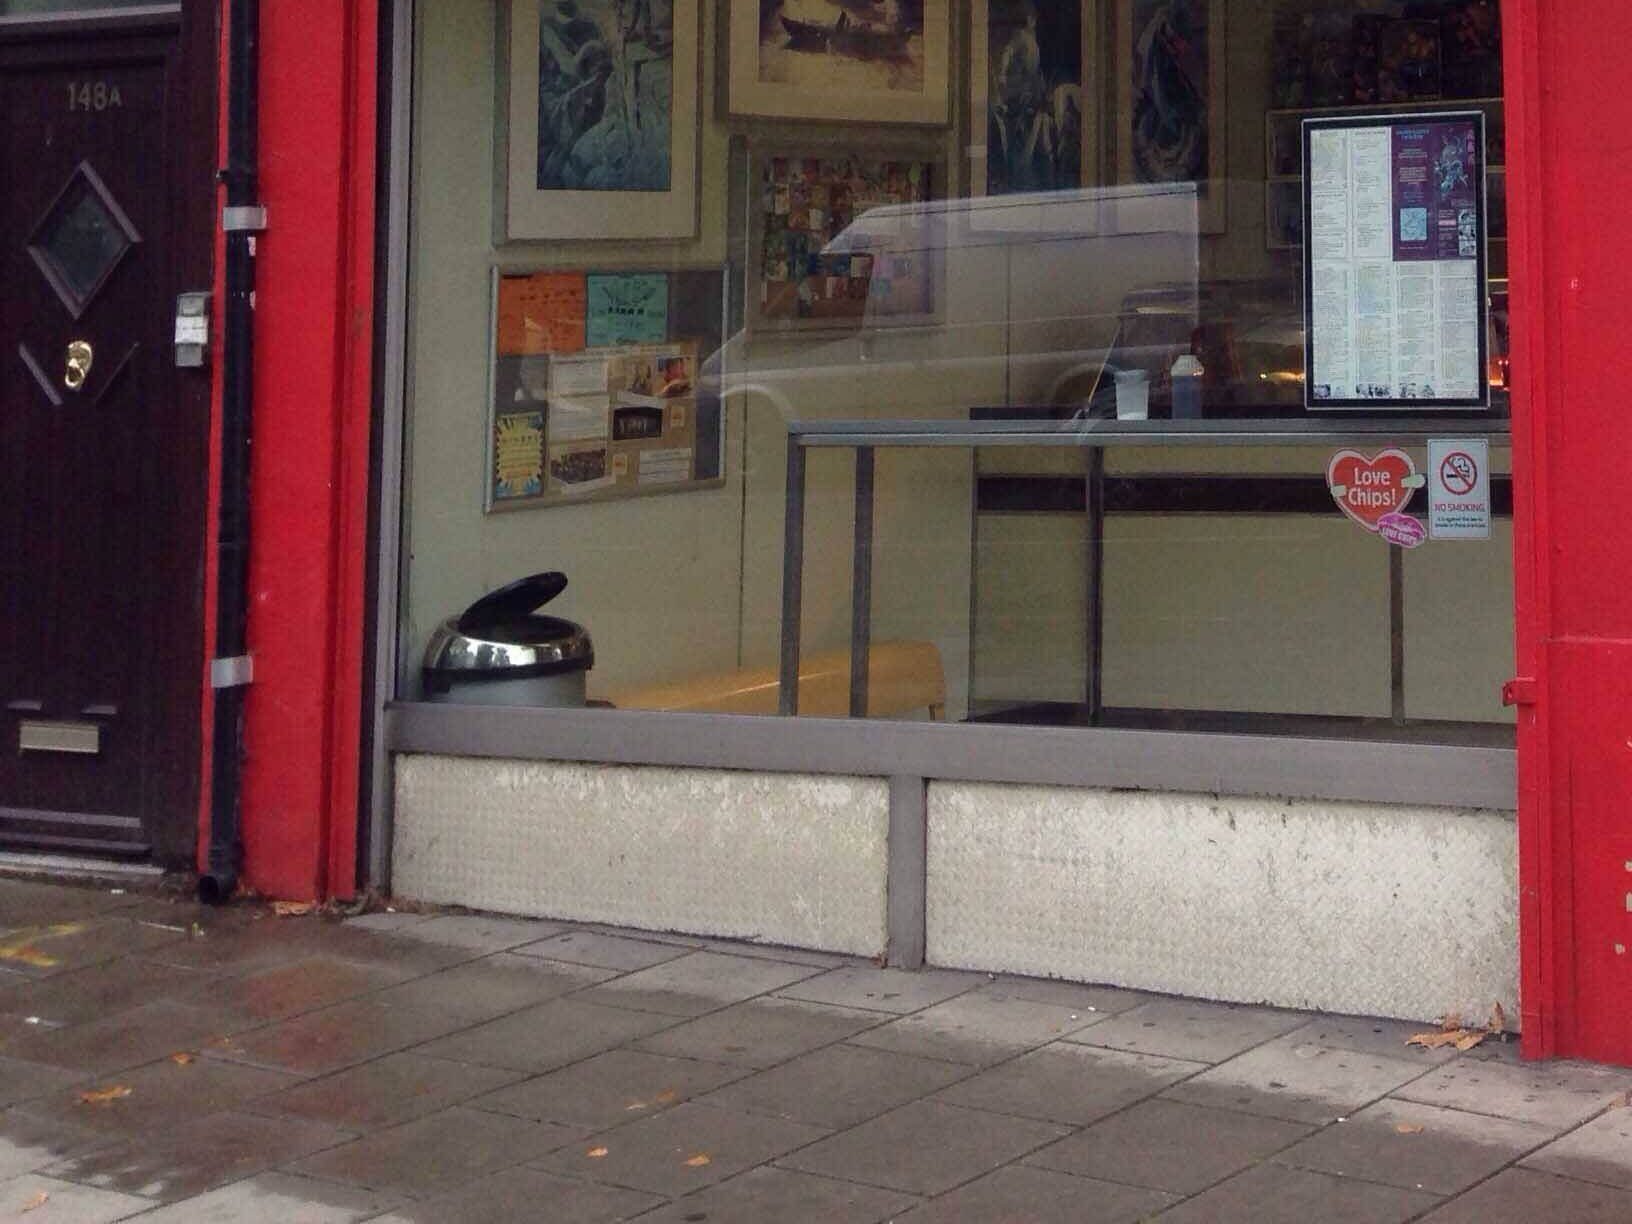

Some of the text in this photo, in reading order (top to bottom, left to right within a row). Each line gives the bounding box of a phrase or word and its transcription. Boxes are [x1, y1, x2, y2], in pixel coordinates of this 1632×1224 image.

[67, 82, 121, 112] 148A
[1354, 467, 1391, 485] Love
[1348, 488, 1396, 508] Chips!
[1434, 503, 1447, 513] NO
